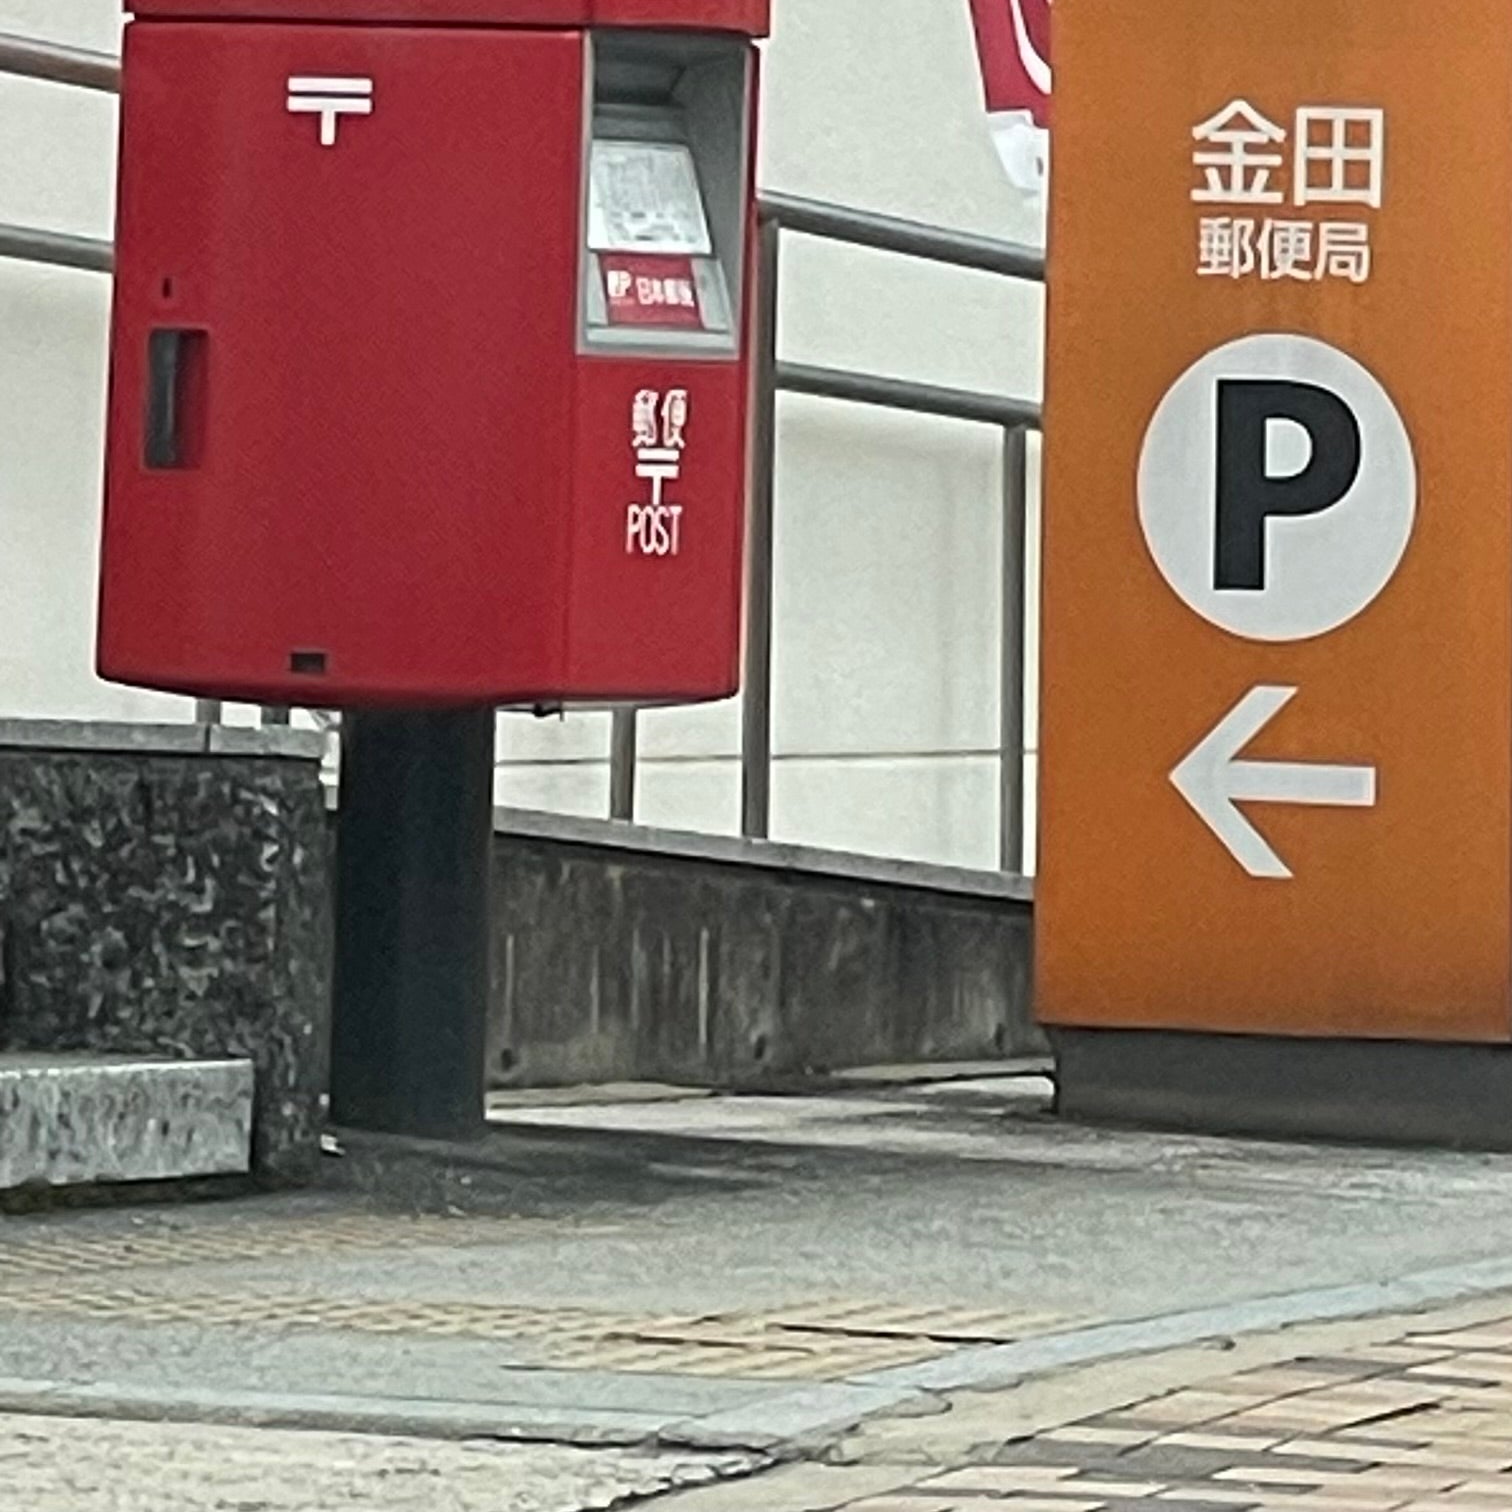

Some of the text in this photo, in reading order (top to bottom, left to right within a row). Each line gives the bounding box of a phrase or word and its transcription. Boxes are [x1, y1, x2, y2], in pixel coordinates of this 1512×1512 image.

[1190, 99, 1384, 209] 金田
[1196, 217, 1370, 283] 郵便局
[631, 389, 688, 449] 郵便
[1213, 379, 1361, 591] P
[626, 504, 683, 556] POST
